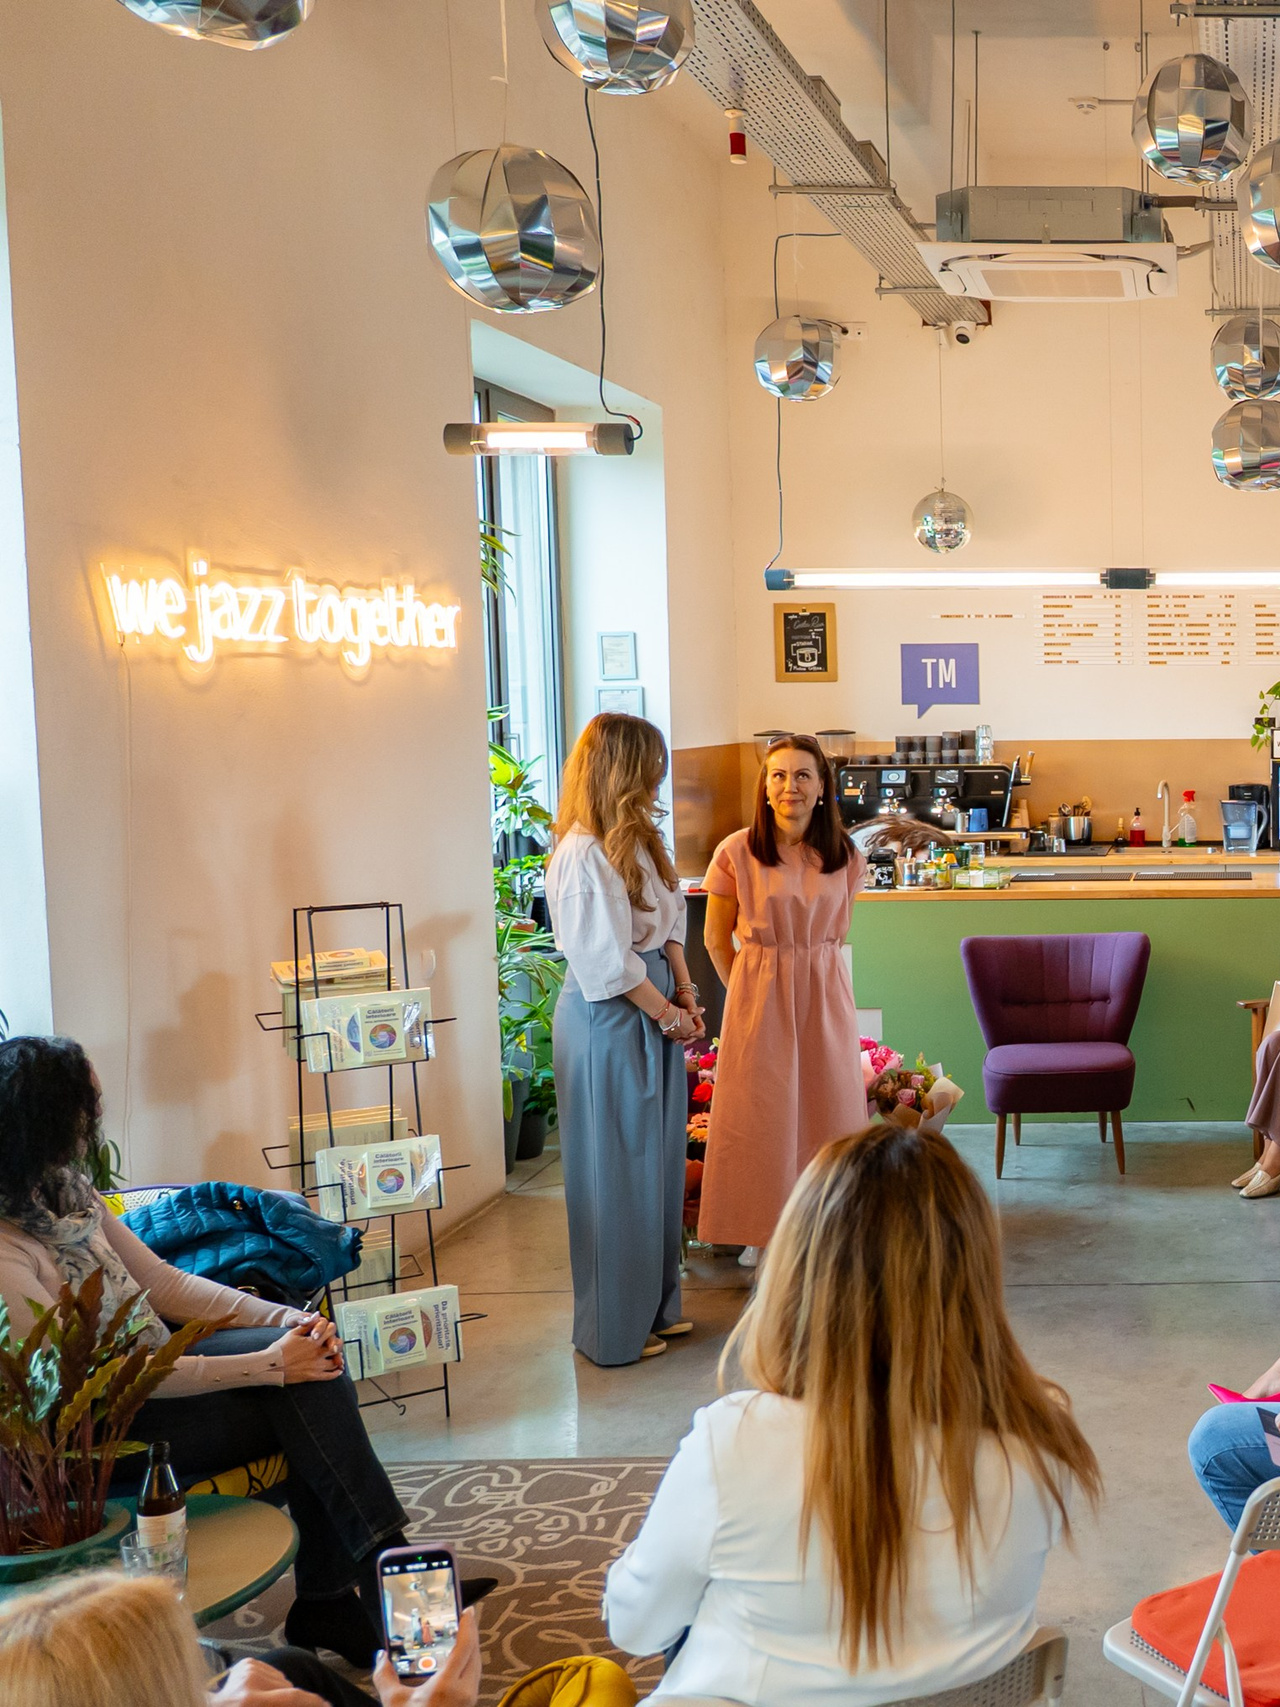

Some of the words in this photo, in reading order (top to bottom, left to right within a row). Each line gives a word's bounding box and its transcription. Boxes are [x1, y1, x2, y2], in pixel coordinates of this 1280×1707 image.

[105, 575, 187, 638] we
[182, 560, 289, 662] jazz
[291, 577, 460, 666] together
[921, 658, 956, 689] TM
